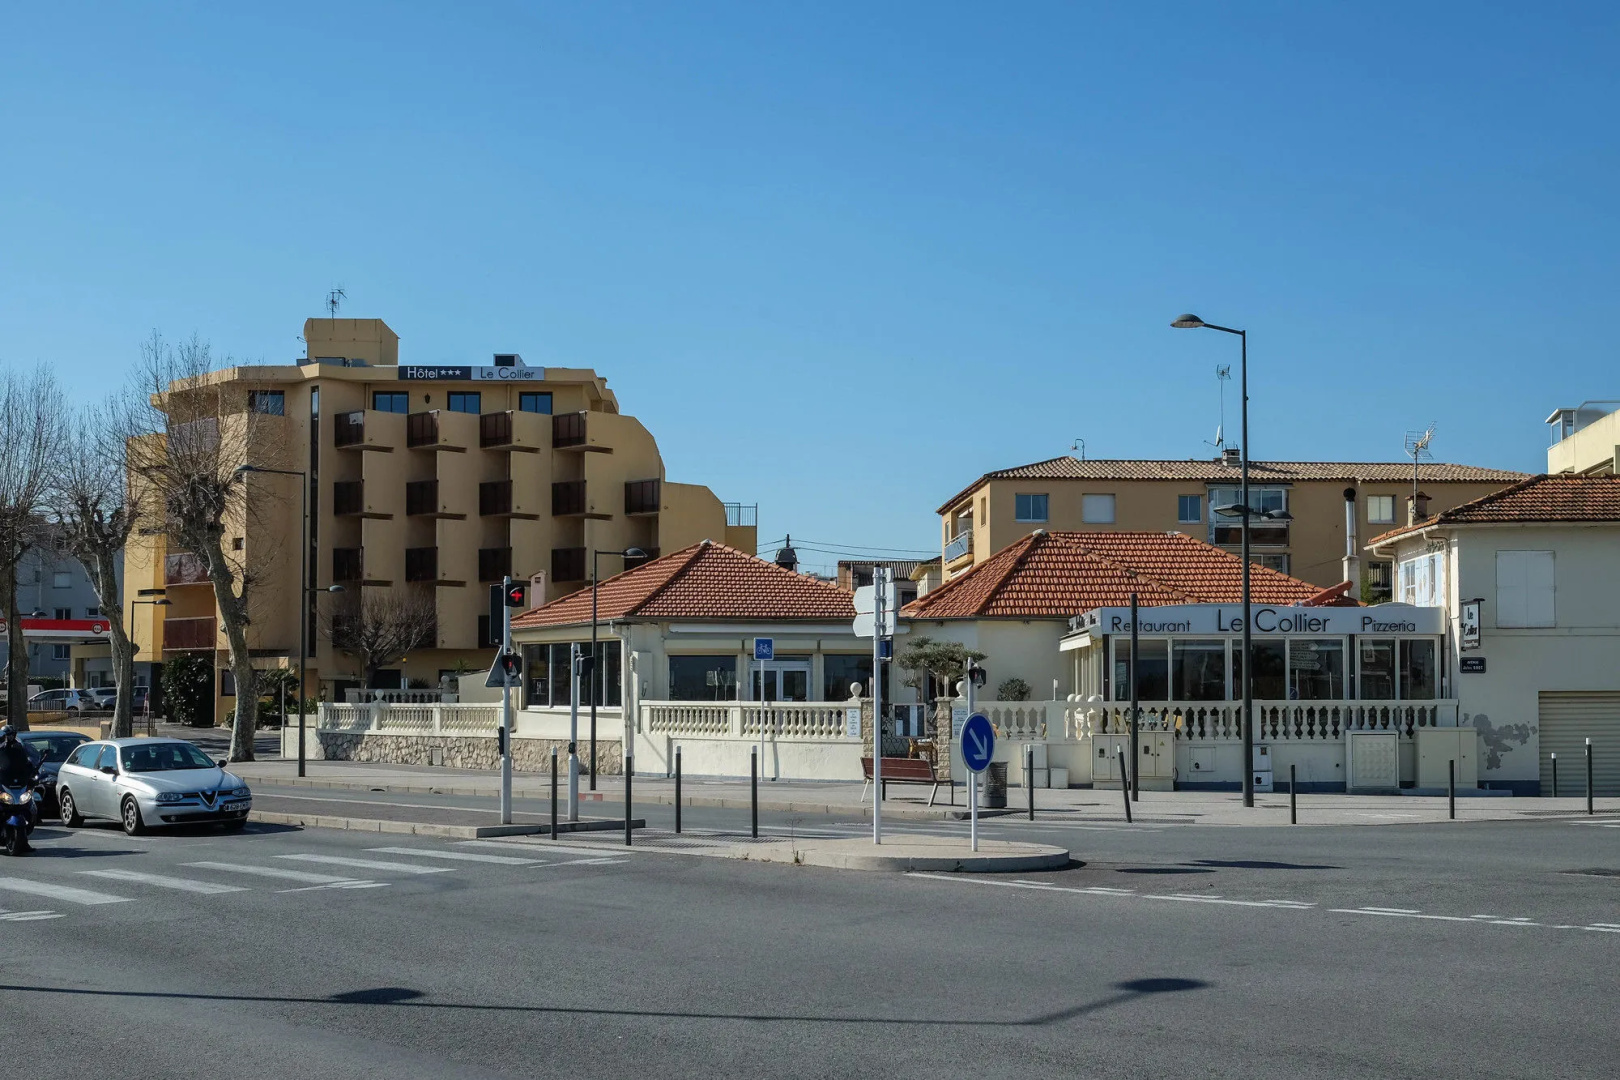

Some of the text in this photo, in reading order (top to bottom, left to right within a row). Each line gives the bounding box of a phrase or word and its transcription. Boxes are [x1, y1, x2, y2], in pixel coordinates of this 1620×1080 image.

[407, 366, 438, 379] Hôtel
[480, 366, 535, 379] Le Collier
[1111, 616, 1191, 632] Retaurant
[1218, 608, 1330, 632] Le Collier
[1362, 616, 1416, 632] Pizzeria
